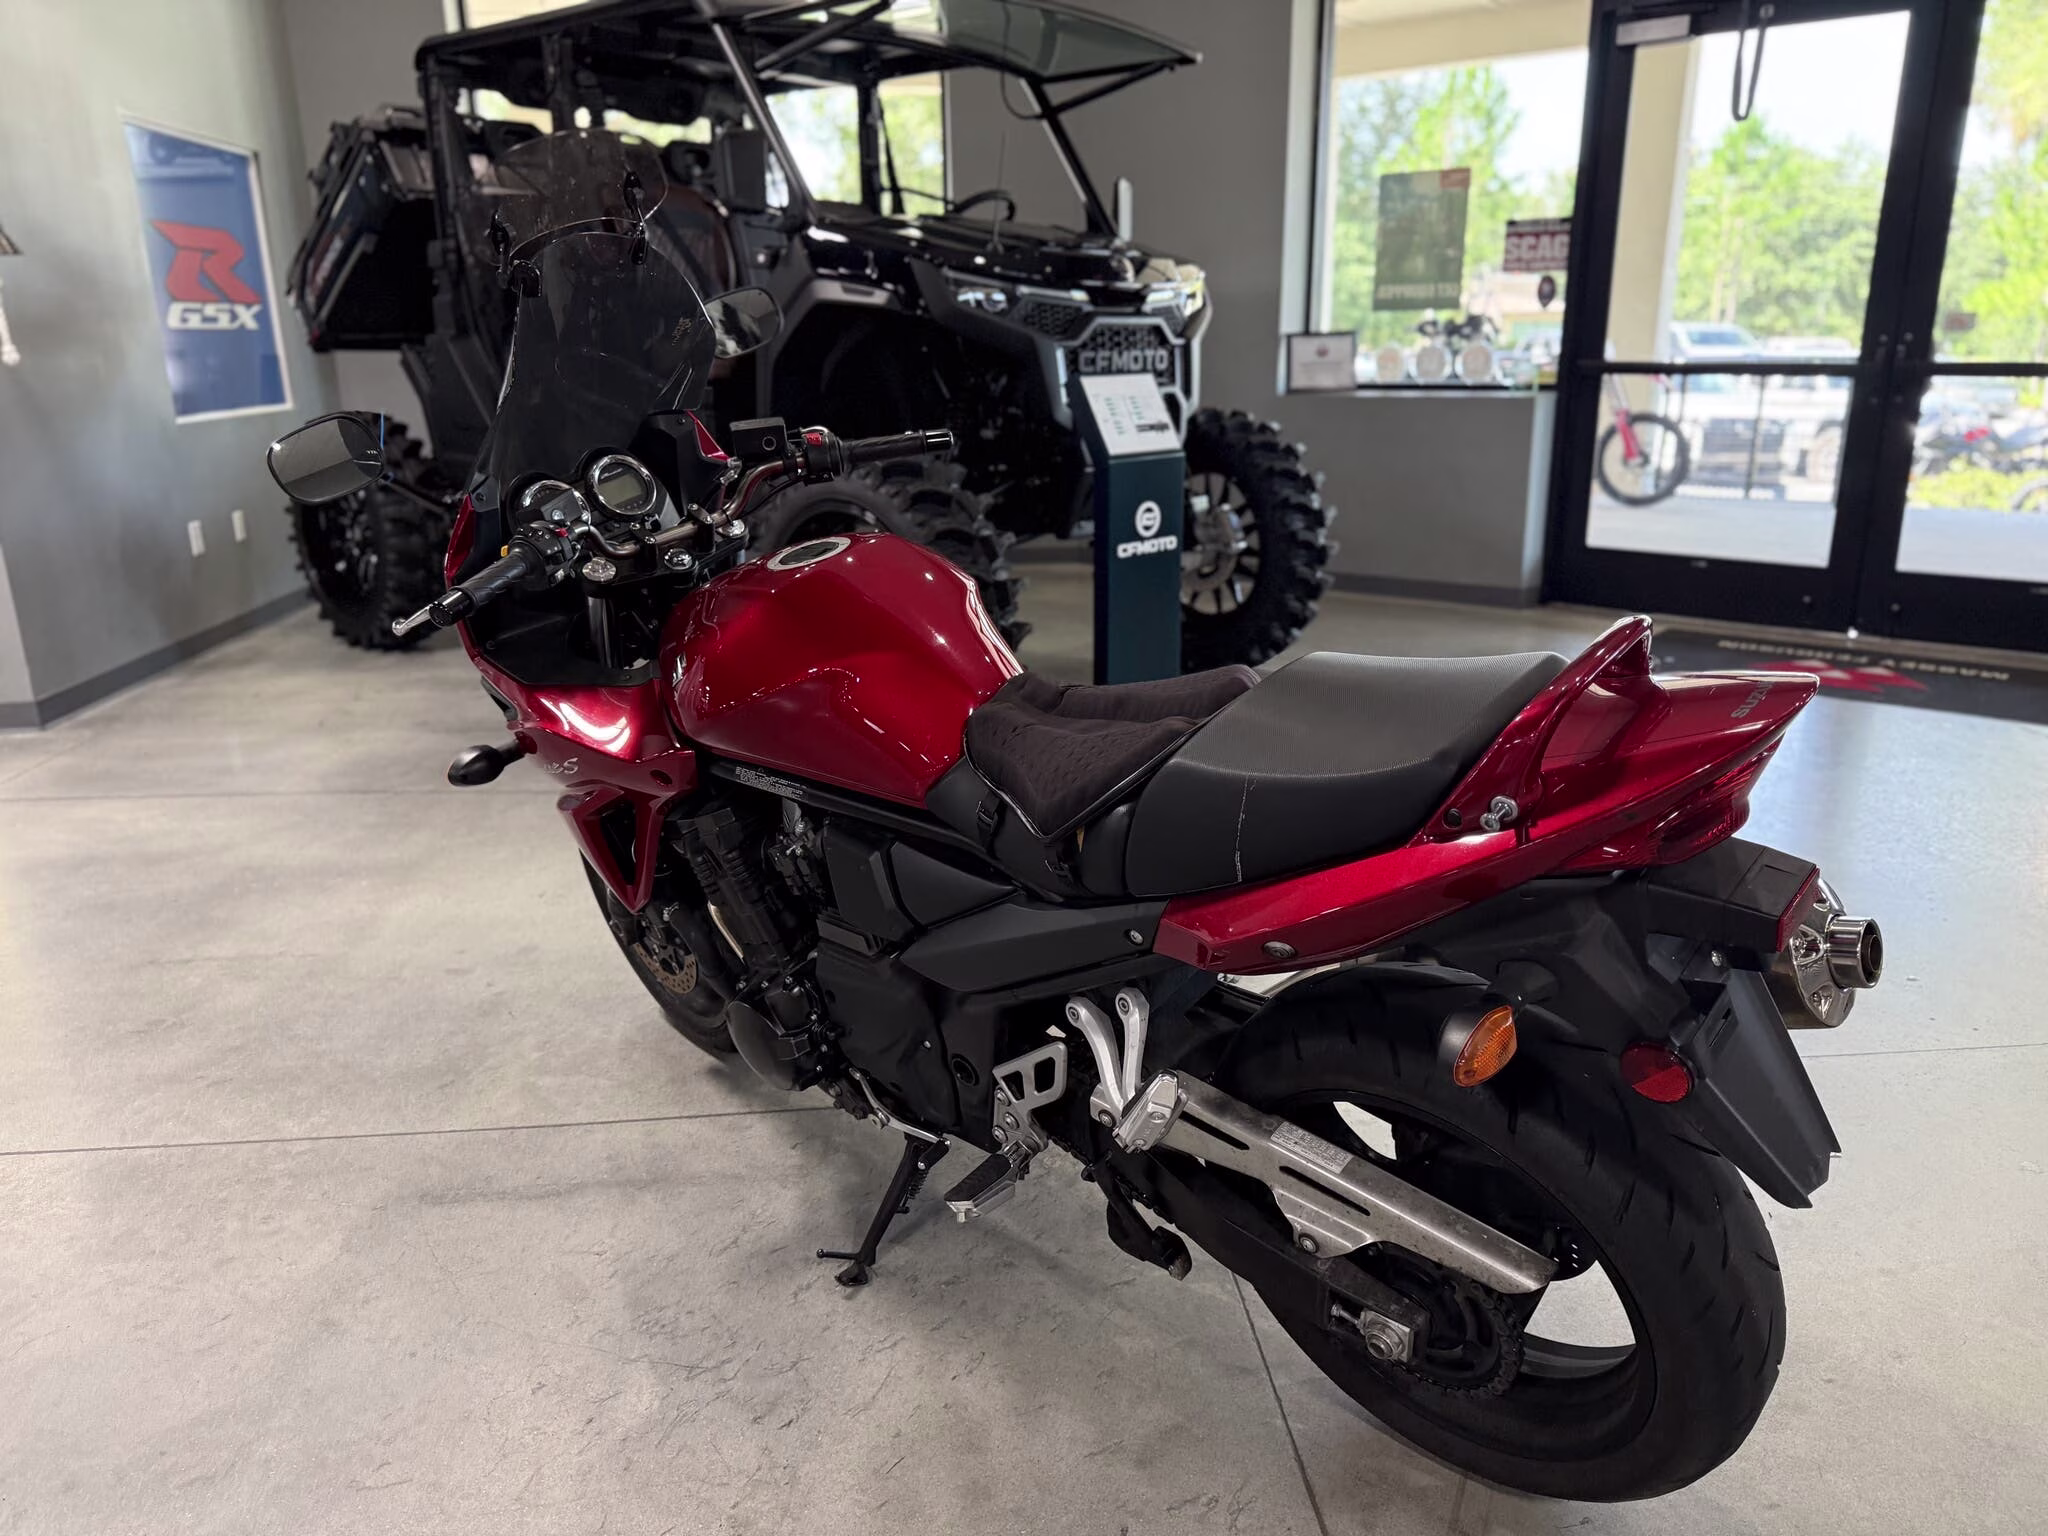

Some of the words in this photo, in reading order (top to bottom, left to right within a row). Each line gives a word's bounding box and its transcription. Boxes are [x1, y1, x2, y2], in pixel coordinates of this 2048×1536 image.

[166, 301, 263, 331] GSX
[1078, 349, 1169, 374] CFMOTO
[1117, 535, 1178, 559] CFMOTO
